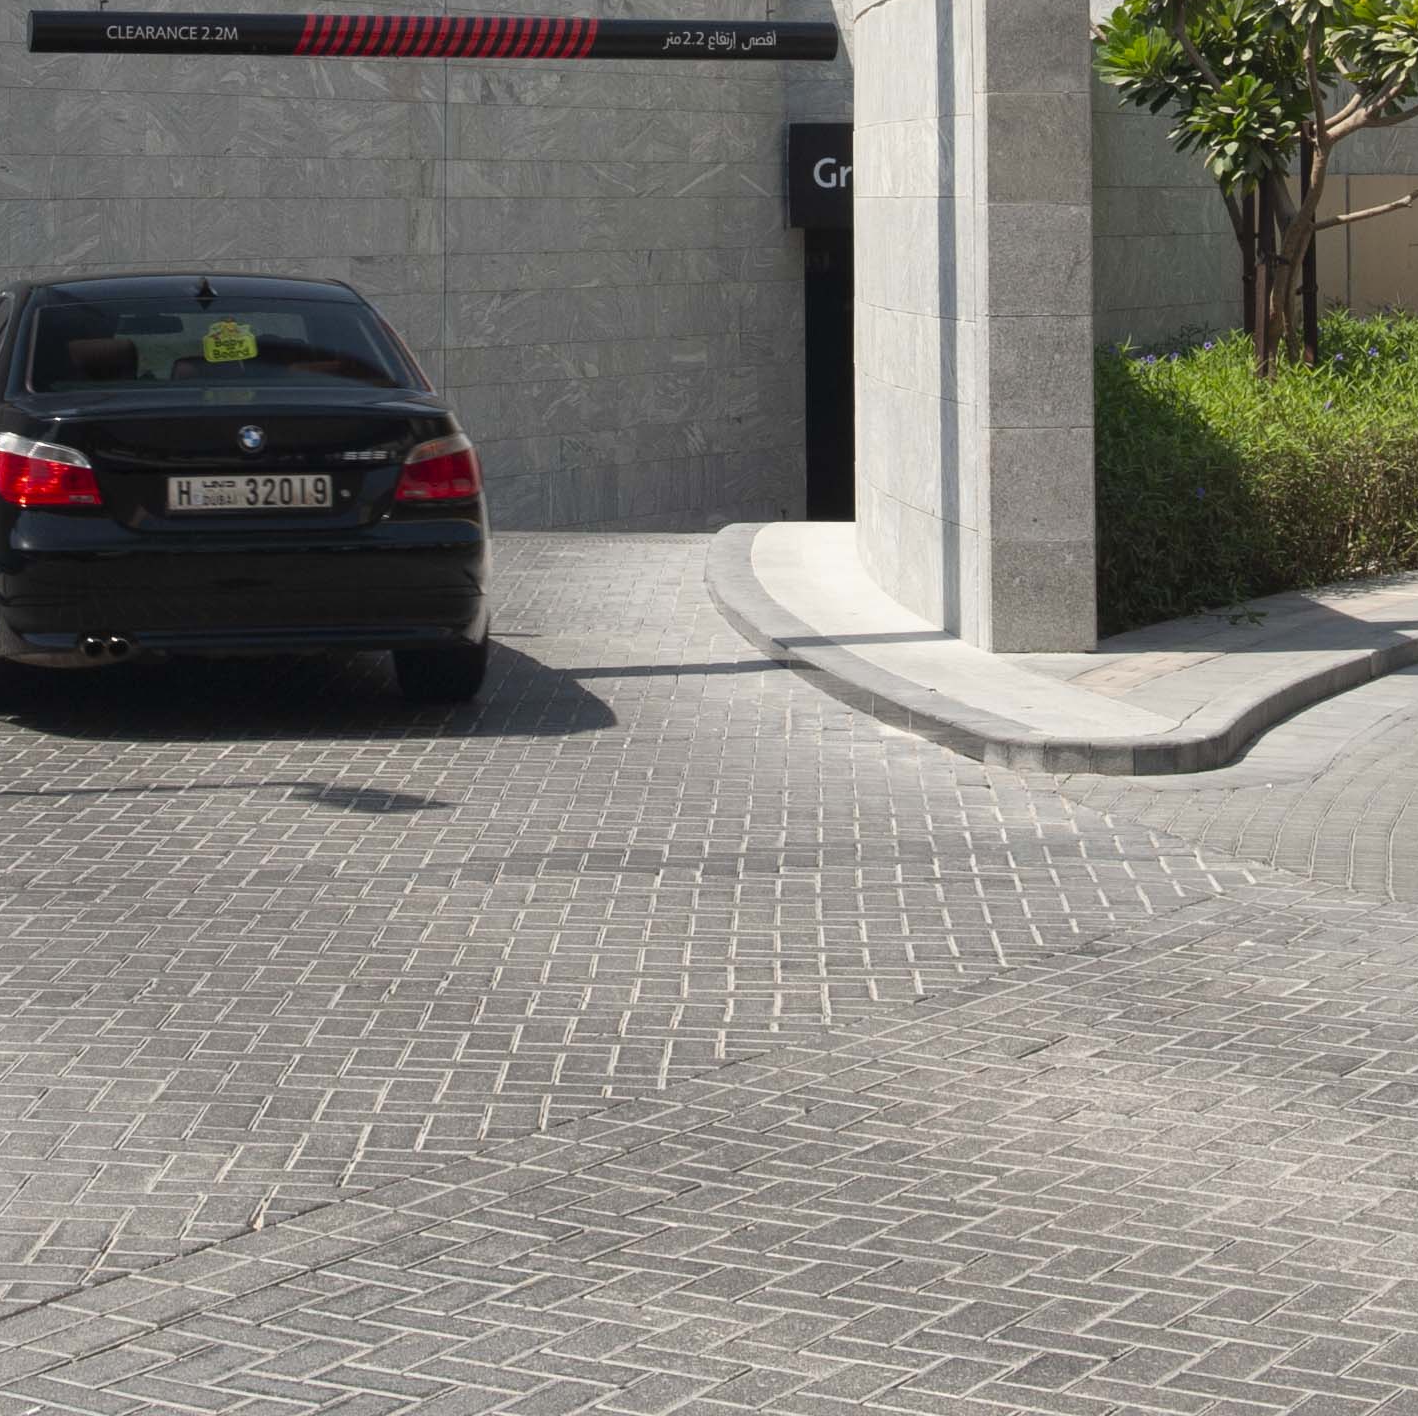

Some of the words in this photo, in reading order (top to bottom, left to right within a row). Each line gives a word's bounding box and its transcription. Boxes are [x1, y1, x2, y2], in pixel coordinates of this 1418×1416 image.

[106, 25, 198, 40] CLEARANCE
[201, 26, 238, 41] 2.2M
[178, 480, 192, 506] H
[245, 477, 328, 506] 32019
